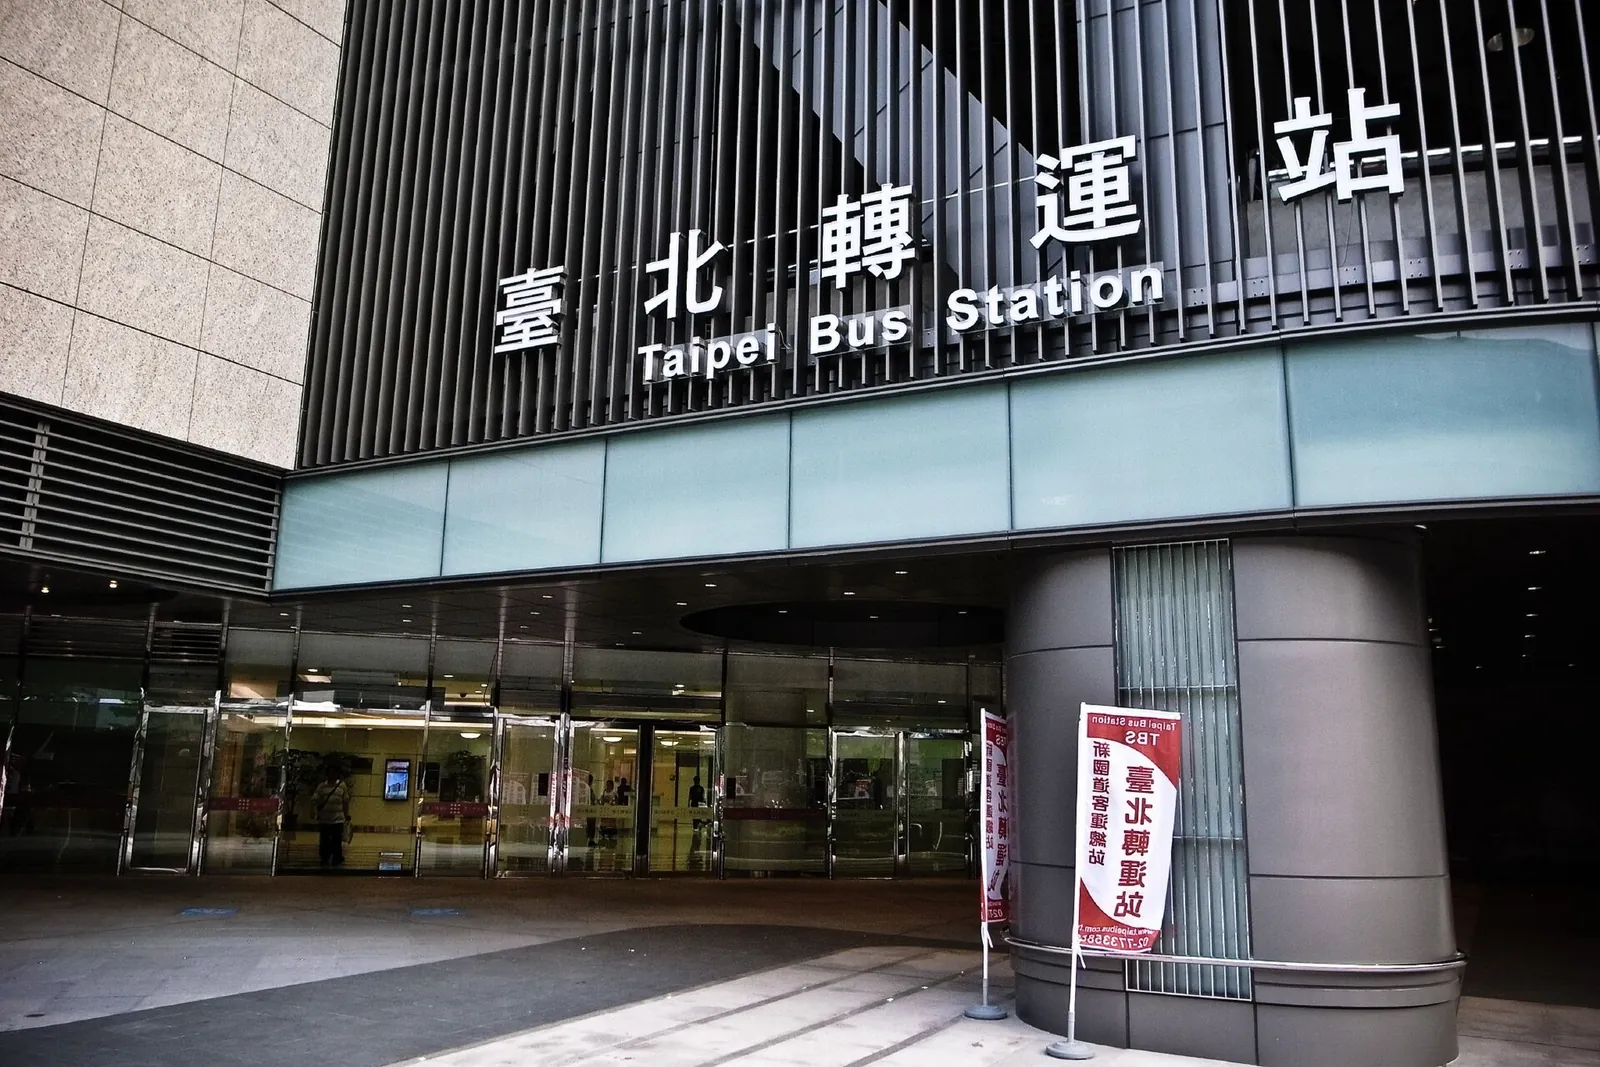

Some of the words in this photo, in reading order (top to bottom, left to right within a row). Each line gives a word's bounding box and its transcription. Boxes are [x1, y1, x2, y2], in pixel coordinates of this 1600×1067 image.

[494, 87, 1404, 354] 臺北轉運站
[638, 323, 777, 382] Taipei
[810, 310, 909, 355] Bus
[946, 266, 1165, 332] Station
